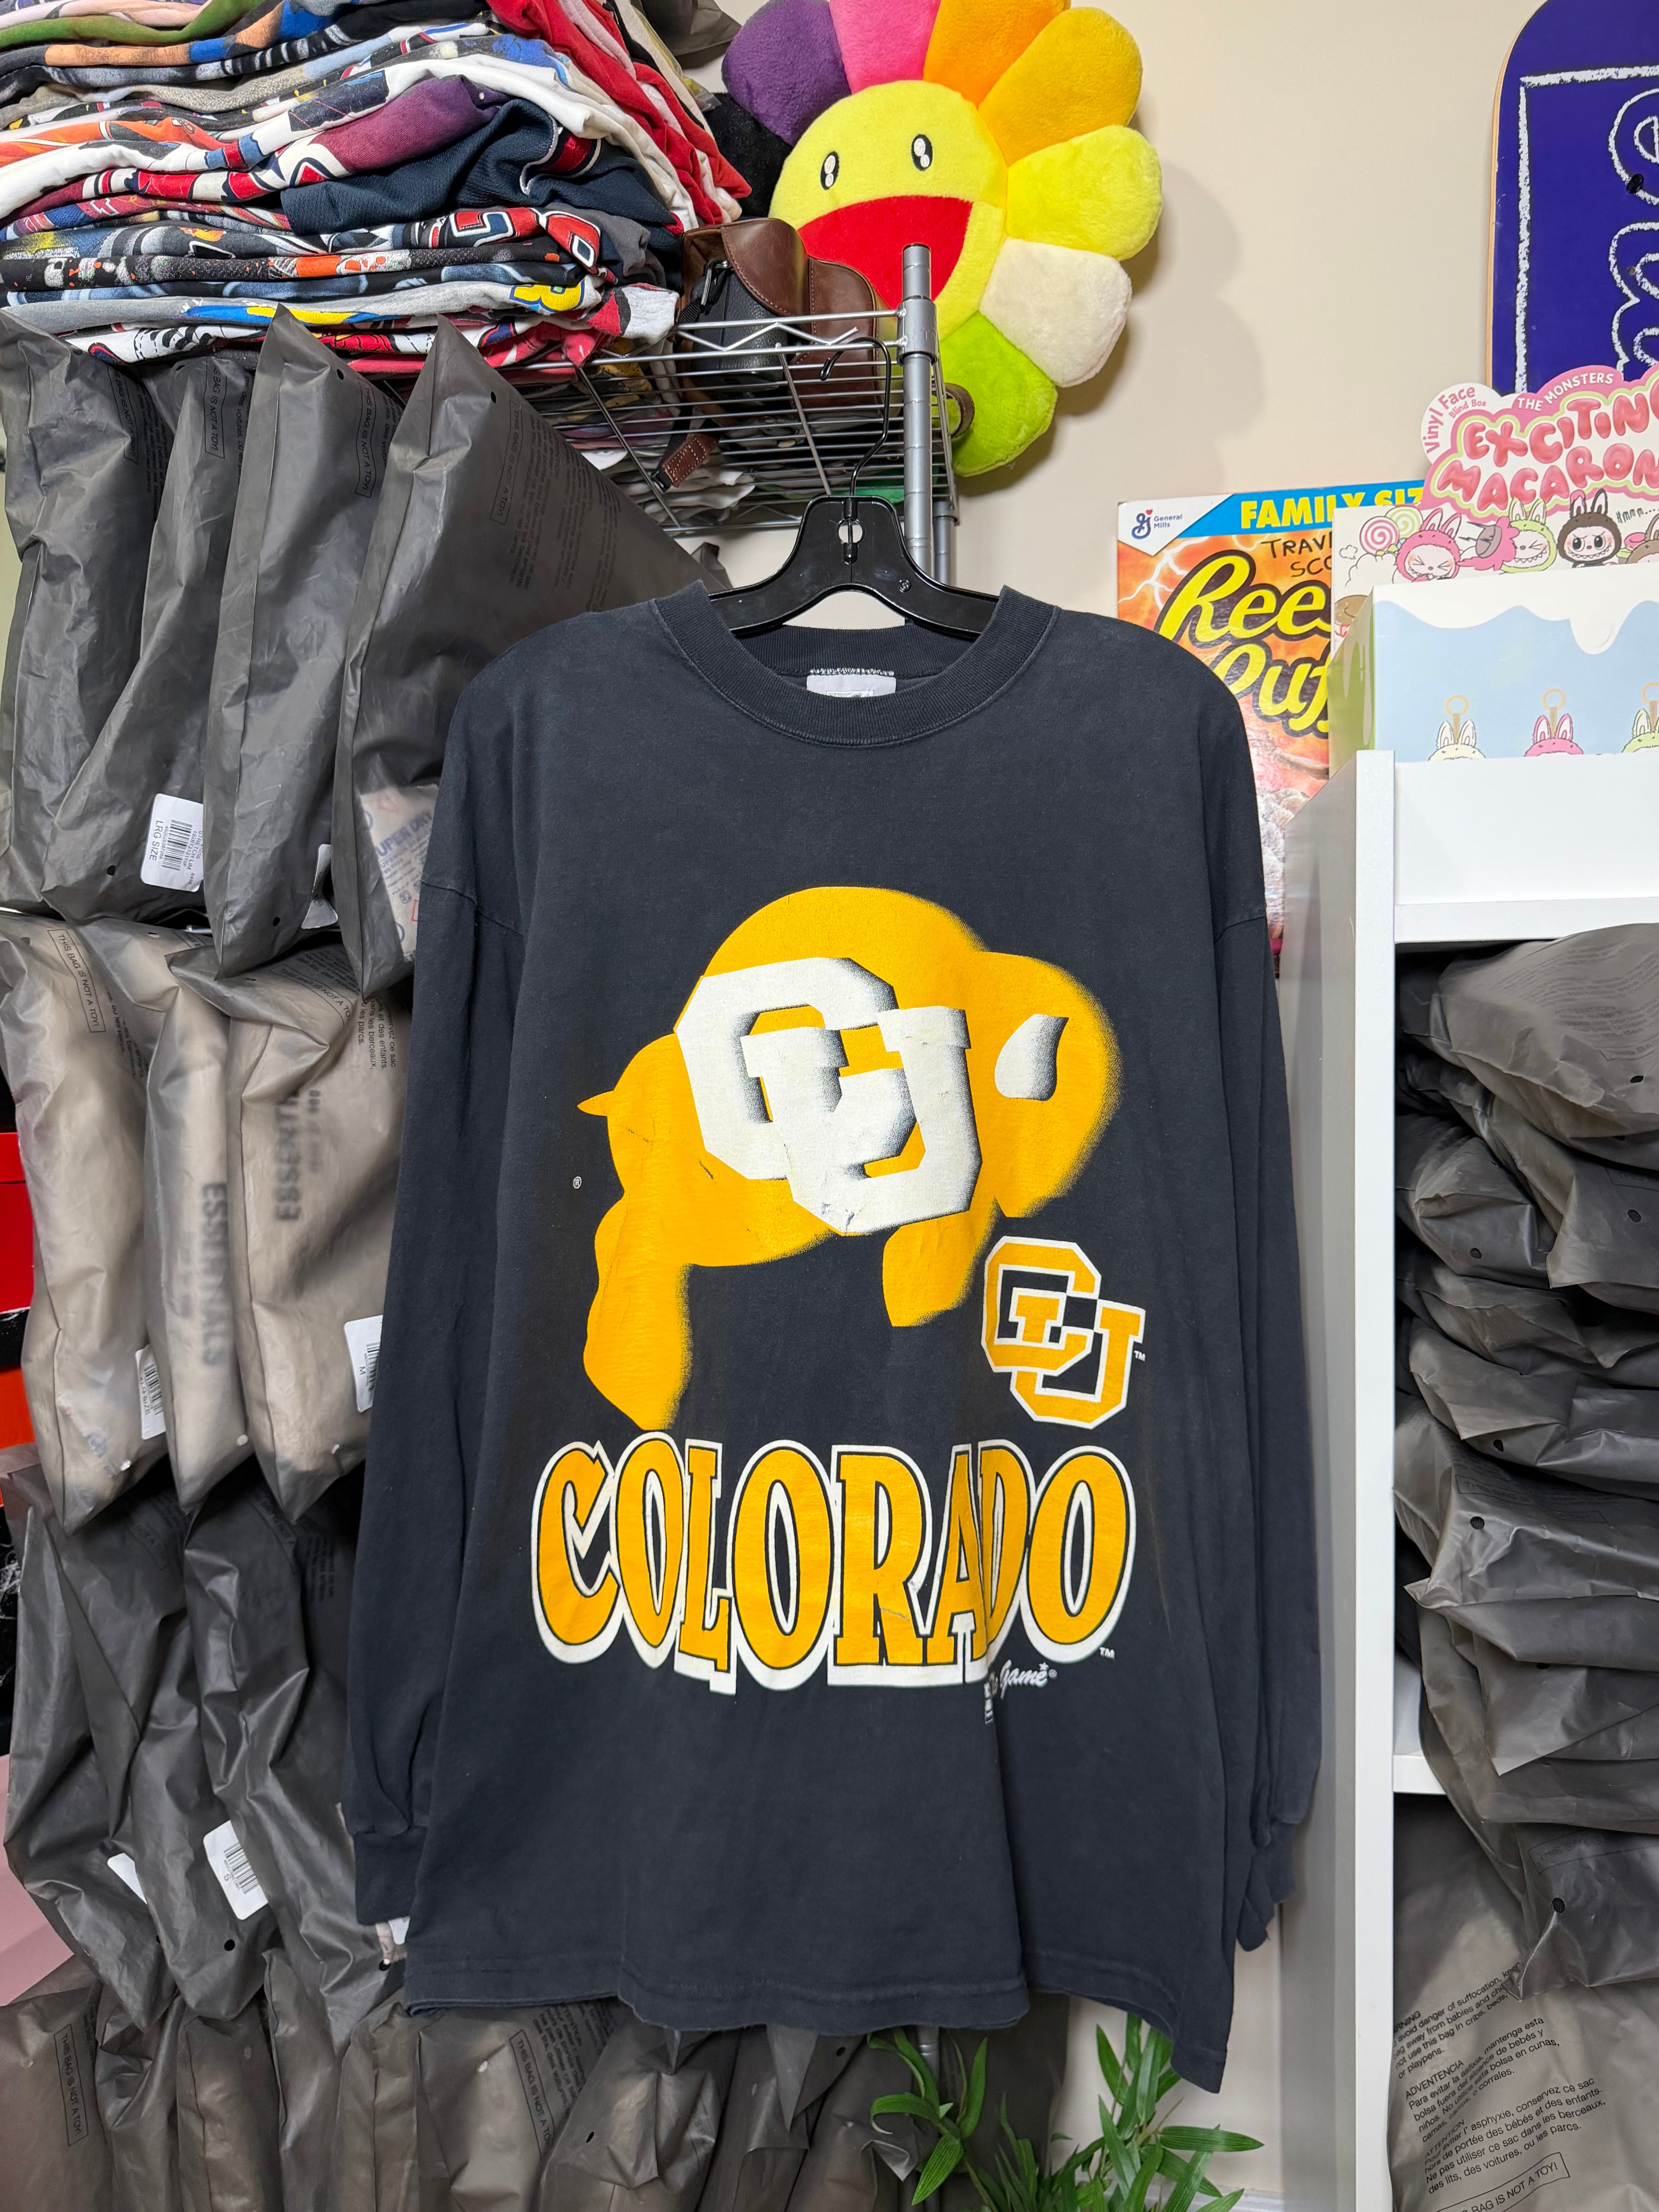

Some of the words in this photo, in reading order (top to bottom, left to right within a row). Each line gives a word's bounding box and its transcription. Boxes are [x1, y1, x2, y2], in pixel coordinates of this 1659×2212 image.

[1449, 400, 1469, 418] Blind
[1471, 399, 1487, 407] Box
[1518, 398, 1541, 411] THE
[1546, 372, 1613, 404] MONSTERS
[1423, 407, 1443, 453] Vinyl
[1438, 387, 1475, 407] Face
[1463, 379, 1659, 467] EXCITIN
[1154, 513, 1182, 521] General
[154, 820, 164, 839] LRG
[149, 841, 160, 861] SIZE
[58, 934, 71, 951] THIS
[67, 953, 81, 969] BAG
[82, 979, 92, 997] NOT
[90, 1008, 100, 1027] TOY!
[321, 988, 339, 1002] NOT
[378, 1013, 385, 1022] et
[369, 1031, 377, 1070] berceaux,
[390, 1042, 396, 1052] ce
[359, 1366, 366, 1375] M
[531, 1431, 1137, 1696] COLORADO
[223, 1873, 231, 1881] S
[1398, 2024, 1417, 2042] avoid
[1419, 2009, 1445, 2028] danger
[1447, 2002, 1456, 2012] of
[1406, 2032, 1425, 2048] away
[1427, 2021, 1445, 2035] from
[1447, 2005, 1474, 2024] babies
[1475, 1995, 1490, 2009] and
[1395, 2056, 1407, 2070] not
[1408, 2047, 1422, 2060] use
[1423, 2037, 1437, 2050] this
[1438, 2028, 1456, 2041] bag
[1456, 2022, 1464, 2031] in
[1398, 2069, 1406, 2079] or
[1407, 2047, 1445, 2074] playpens.
[1408, 2093, 1428, 2110] Para
[1430, 2082, 1450, 2099] evitar
[1452, 2075, 1460, 2085] la
[1484, 2027, 1523, 2054] mantenga
[1524, 2017, 1544, 2030] esta
[1405, 2059, 1465, 2100] ADVENTENCIA
[1413, 2105, 1437, 2122] bolsa
[1437, 2090, 1456, 2107] fuera
[1496, 2046, 1507, 2056] de
[1508, 2032, 1536, 2050] bebés
[1538, 2028, 1544, 2037] y
[1442, 2103, 1453, 2115] No
[1490, 2056, 1513, 2071] bolsa
[1515, 2049, 1527, 2059] en
[1528, 2038, 1560, 2052] cunas,
[1478, 2067, 1515, 2091] corrales.
[1471, 2109, 1514, 2133] asphyxie,
[1516, 2086, 1561, 2114] conservez
[1563, 2085, 1576, 2094] ce
[1577, 2077, 1595, 2090] sac
[1426, 2172, 1438, 2183] Ne
[1439, 2161, 1456, 2177] pas
[1456, 2147, 1486, 2167] utiliser
[1488, 2142, 1501, 2154] ce
[1502, 2134, 1520, 2148] sac
[1521, 2121, 1542, 2139] dans
[1542, 2112, 1557, 2124] les
[1559, 2098, 1606, 2119] berceaux,
[1443, 2150, 1453, 2161] de
[1455, 2135, 1484, 2155] portée
[1486, 2126, 1504, 2139] des
[1506, 2113, 1534, 2133] bébés
[1535, 2106, 1544, 2117] et
[1545, 2097, 1564, 2110] des
[1429, 2179, 1444, 2194] des
[1445, 2171, 1462, 2184] lits,
[1464, 2163, 1482, 2177] des
[1483, 2148, 1523, 2170] voitures,
[1524, 2139, 1535, 2151] ou
[1536, 2129, 1549, 2143] les
[1551, 2122, 1582, 2136] parcs.
[1495, 2194, 1506, 2206] IS
[1506, 2180, 1526, 2200] NOT
[1528, 2176, 1535, 2187] A
[1535, 2161, 1558, 2180] TOY!
